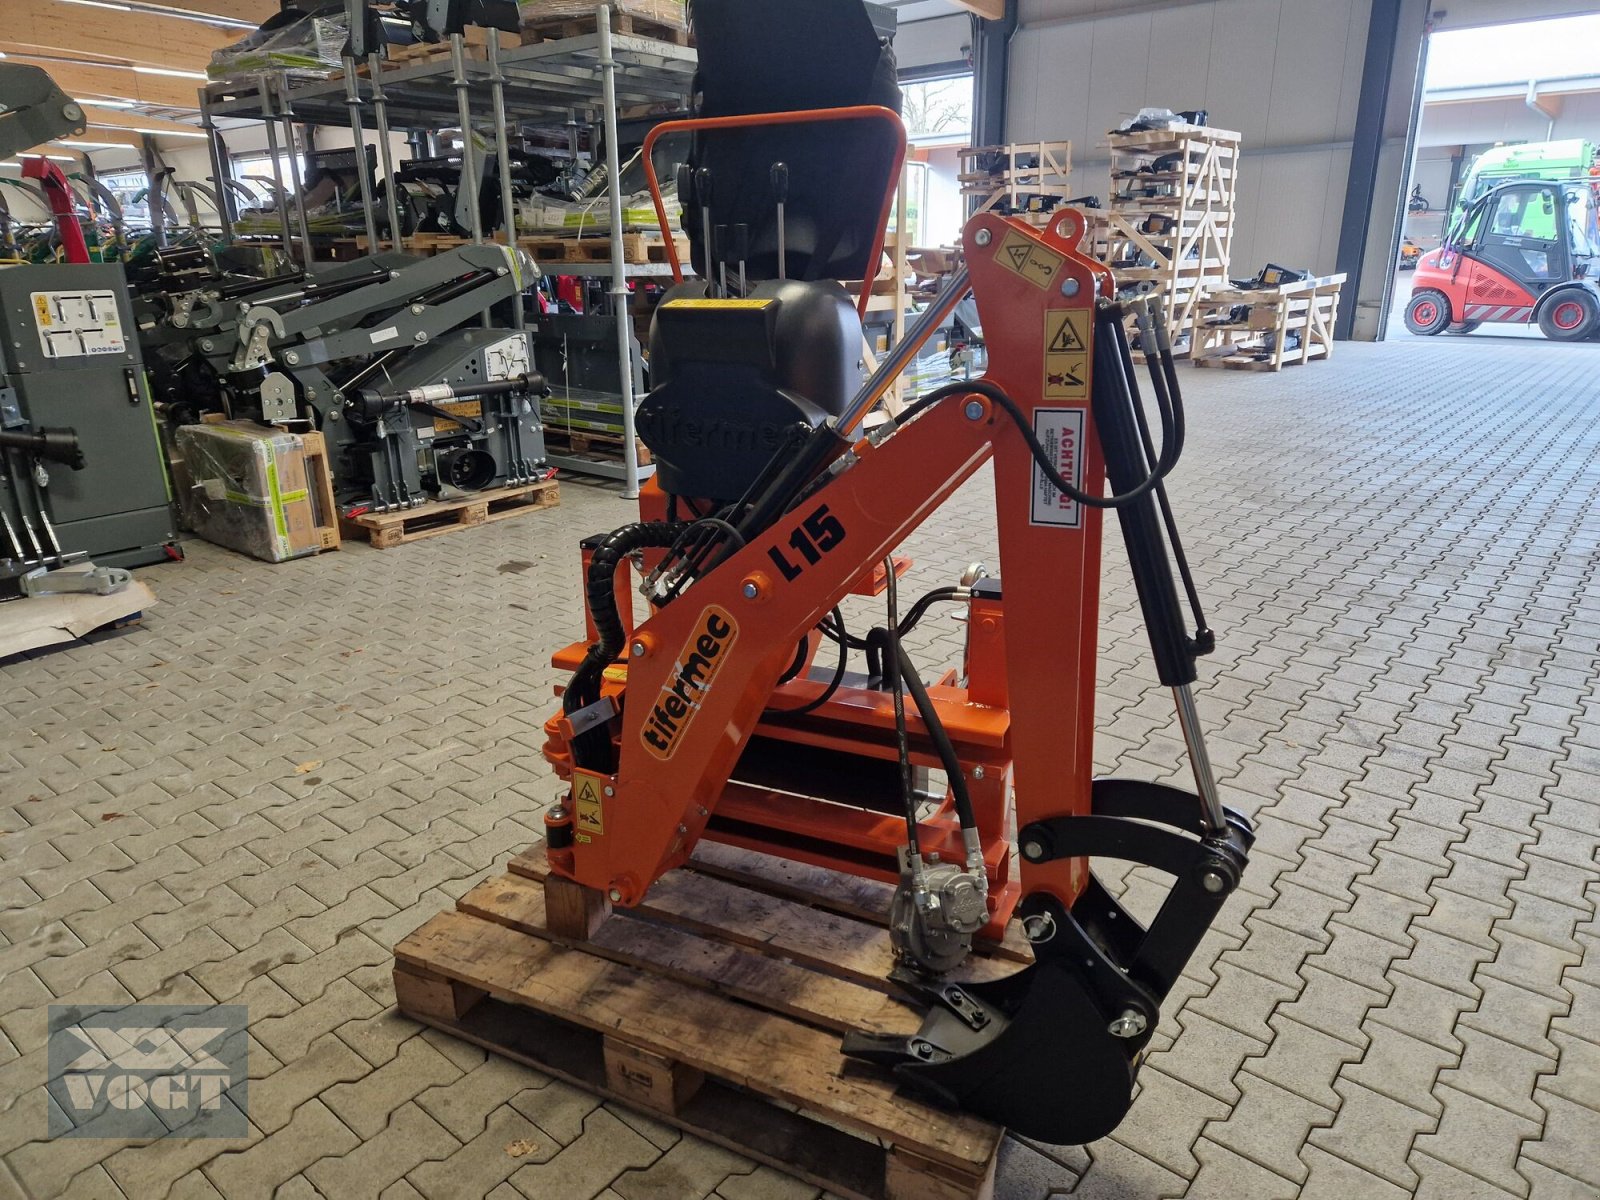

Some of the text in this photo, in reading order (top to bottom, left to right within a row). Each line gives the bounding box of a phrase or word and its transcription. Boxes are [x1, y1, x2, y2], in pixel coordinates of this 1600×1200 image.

[1059, 427, 1075, 510] ACHTUG!
[767, 503, 847, 582] L15
[643, 613, 731, 751] tifermec
